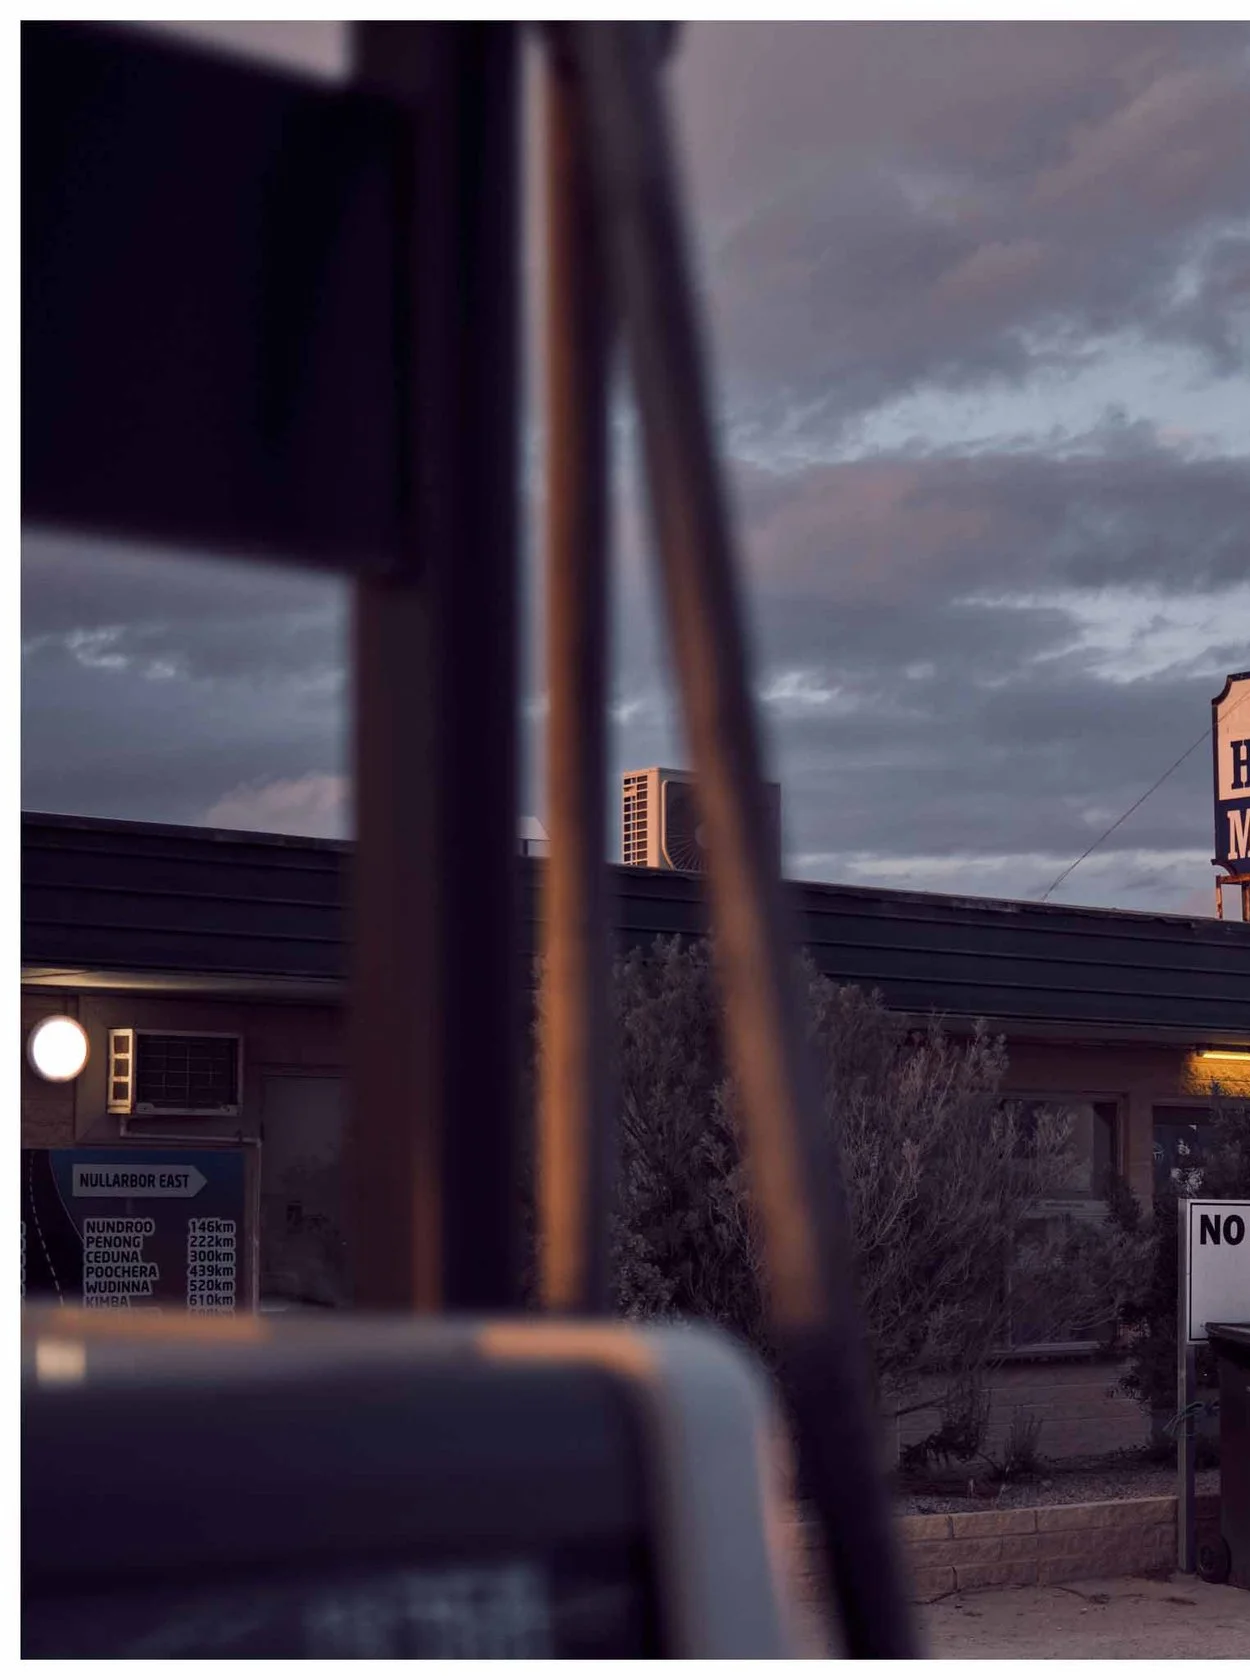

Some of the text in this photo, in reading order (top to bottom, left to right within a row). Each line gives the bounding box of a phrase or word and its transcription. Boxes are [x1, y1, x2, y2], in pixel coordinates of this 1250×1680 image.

[79, 1173, 190, 1189] NULLARBOR EAST
[86, 1221, 234, 1234] NUNDROO 146km
[1200, 1214, 1245, 1246] NO
[86, 1235, 234, 1249] PENONG 222km
[86, 1250, 234, 1263] CEDUNA 300km
[86, 1265, 234, 1279] POOCHERA 439km
[86, 1279, 234, 1294] WUDINNA 520km
[86, 1294, 234, 1308] KIMBA 610km
